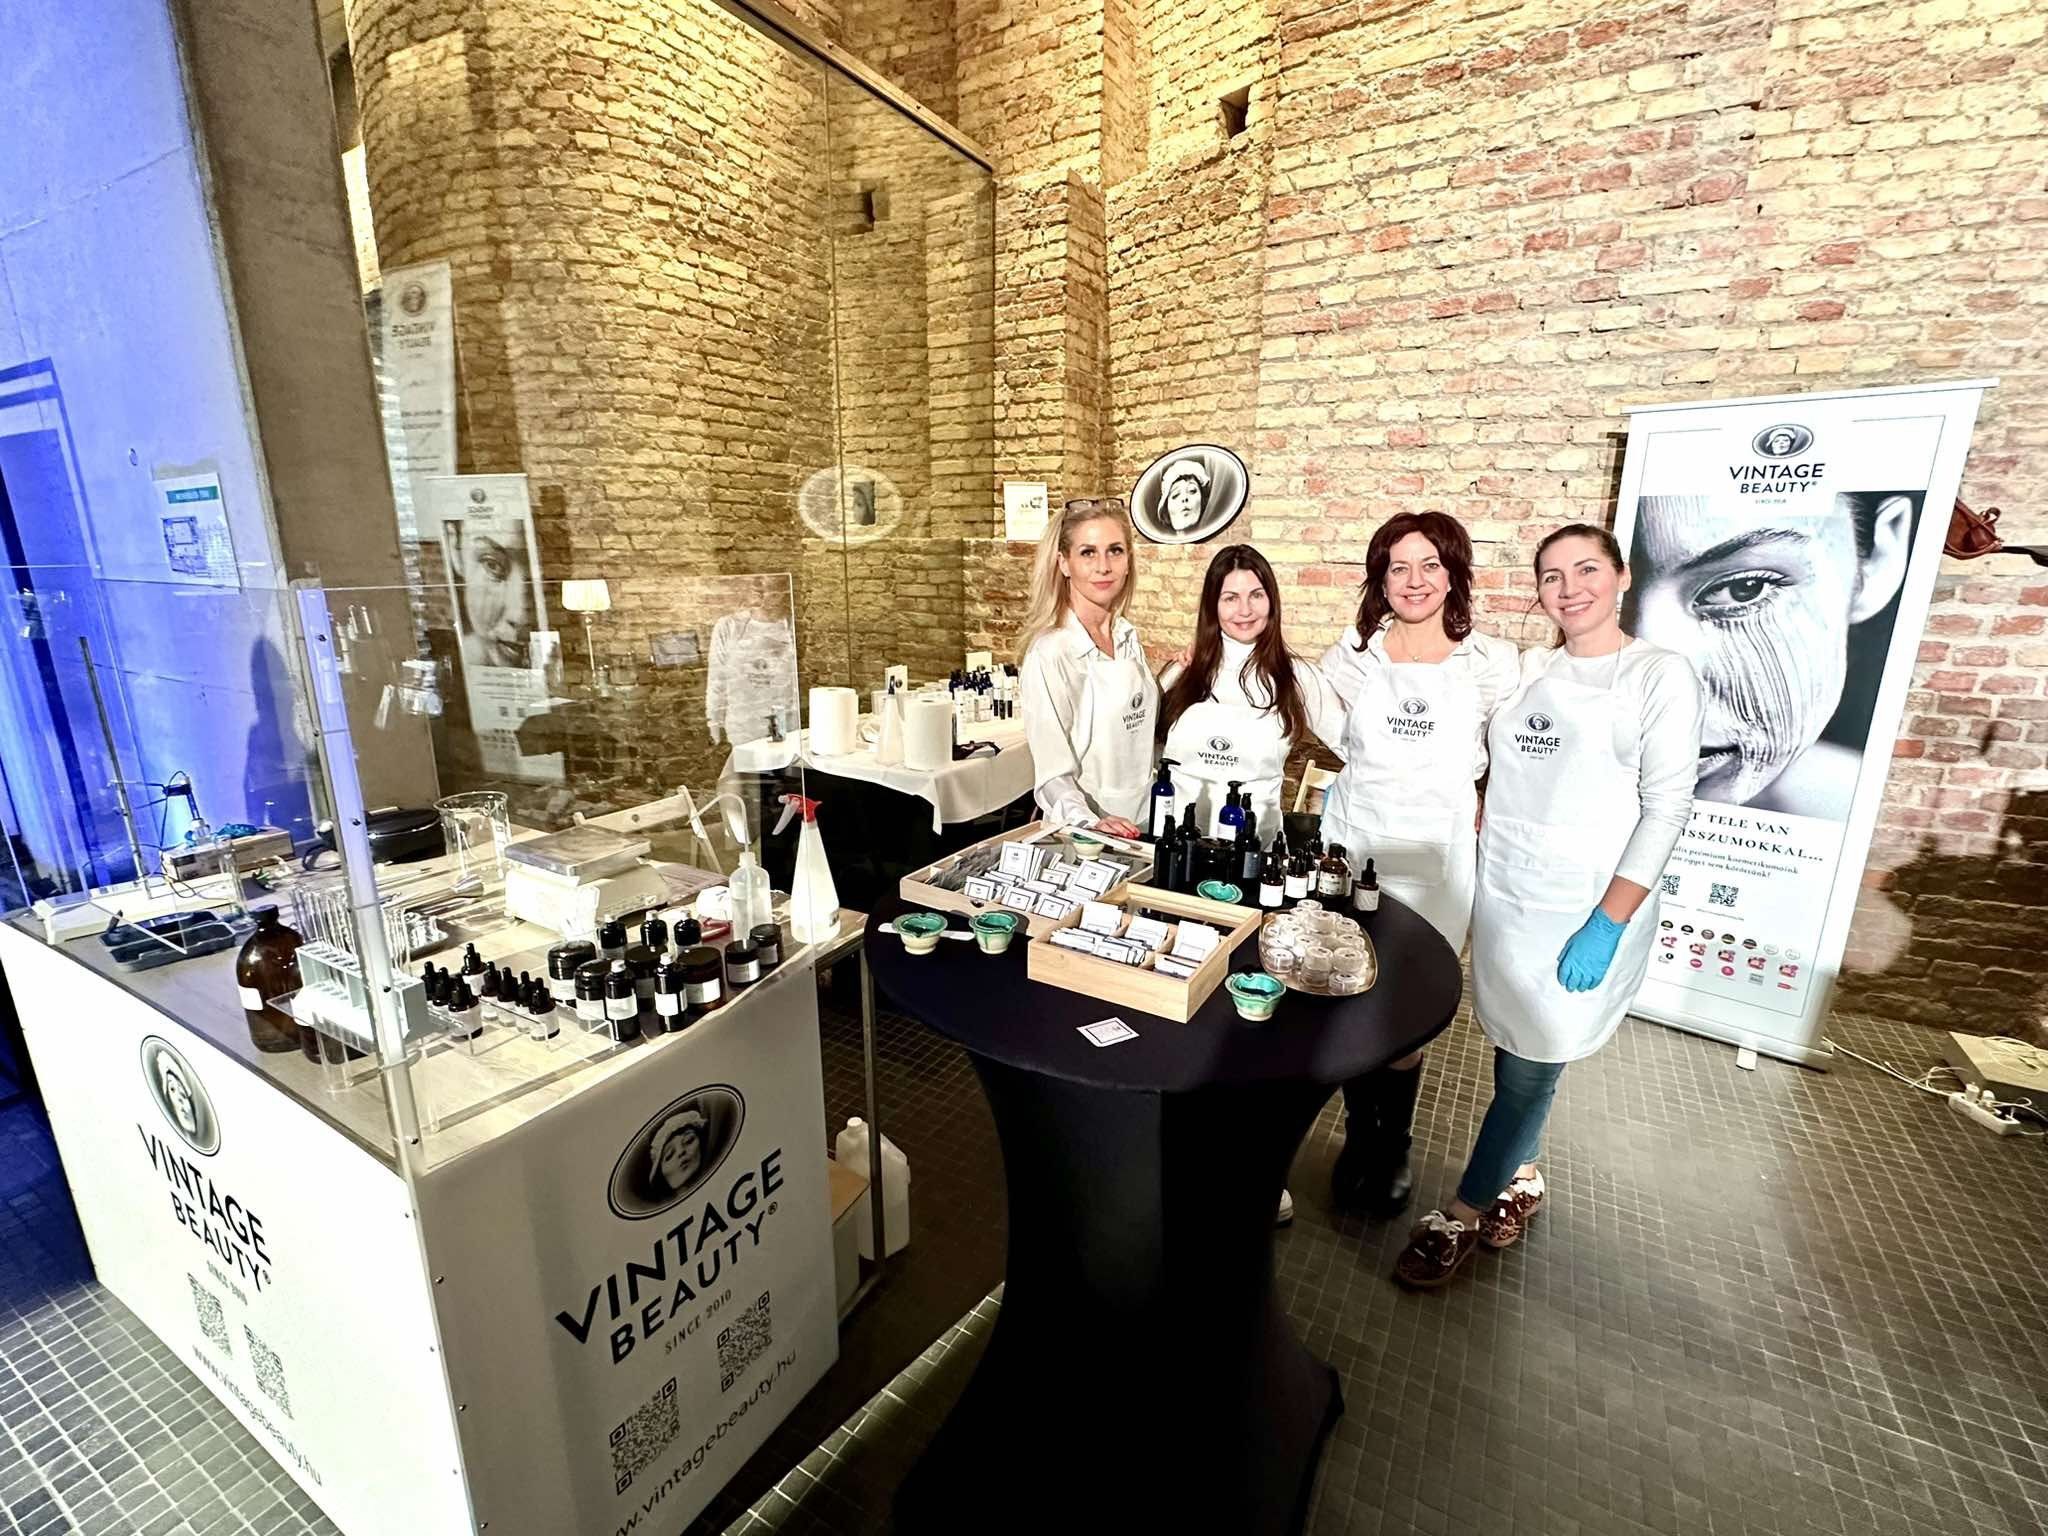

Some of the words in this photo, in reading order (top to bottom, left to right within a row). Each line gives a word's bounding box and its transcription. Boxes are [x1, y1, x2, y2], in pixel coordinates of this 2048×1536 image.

[1729, 463, 1826, 480] VINTAGE
[1122, 709, 1146, 724] VINTAGE
[1386, 715, 1436, 731] VINTAGE
[1514, 733, 1561, 748] VINTAGE
[1197, 751, 1239, 763] VINTAGE
[1707, 814, 1748, 829] TELE
[1755, 822, 1789, 836] VAN
[1681, 828, 1824, 862] ISSZUMOKKAL...
[137, 1123, 272, 1266] VINTAGE
[555, 1148, 784, 1345] VINTAGE
[665, 1314, 701, 1355] SINCE
[706, 1289, 731, 1319] 2010
